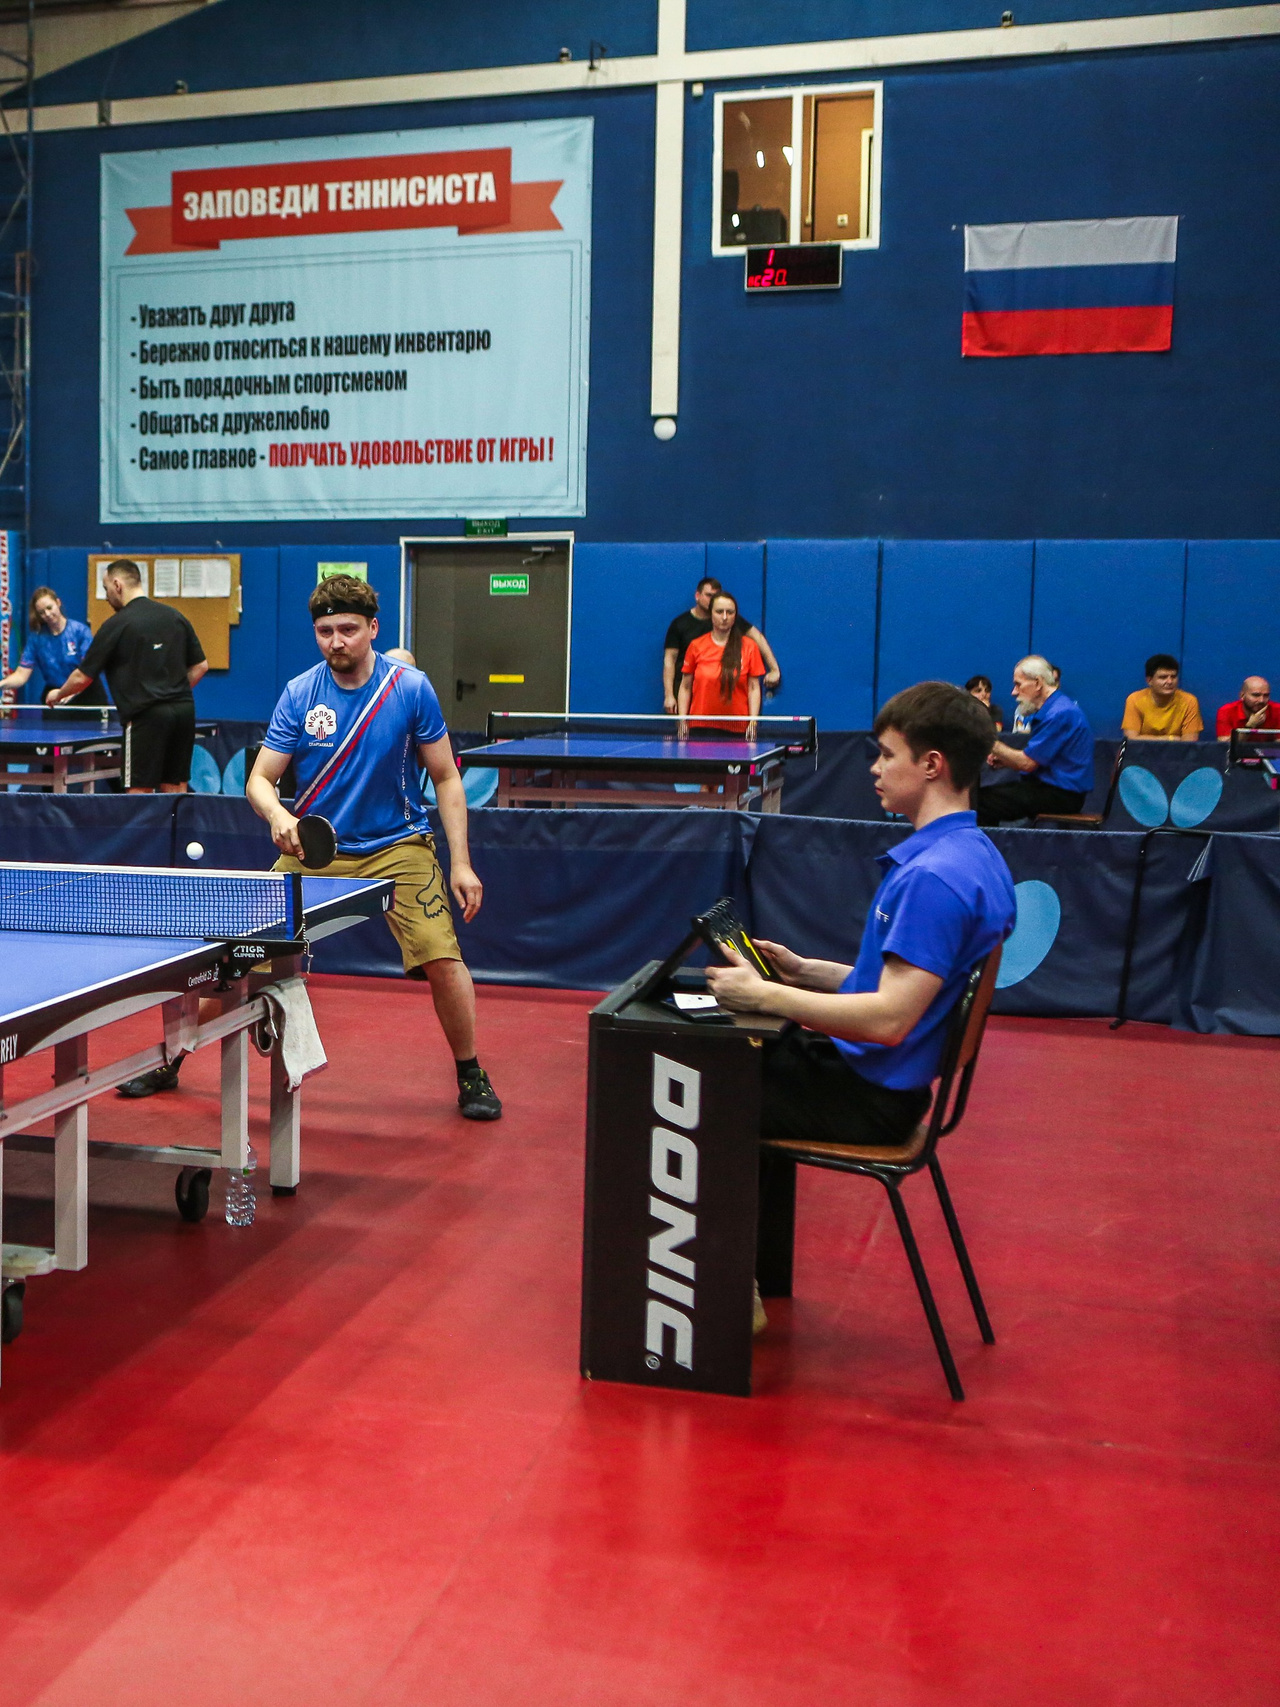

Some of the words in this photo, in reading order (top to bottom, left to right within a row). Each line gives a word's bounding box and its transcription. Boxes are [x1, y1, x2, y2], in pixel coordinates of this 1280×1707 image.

[183, 183, 320, 221] ЗАПОВЕДИ
[324, 171, 497, 212] ТЕННИСИСТА
[139, 303, 207, 329] Уважать
[209, 303, 246, 329] друг
[248, 300, 296, 327] друга
[139, 339, 211, 366] Бережно
[213, 336, 308, 361] относиться
[310, 336, 321, 357] к
[323, 333, 392, 357] нашему
[394, 329, 492, 354] инвентарю
[139, 375, 181, 400] Быть
[183, 373, 291, 400] порядочным
[293, 369, 408, 396] спортсменом
[139, 410, 219, 438] Общаться
[221, 405, 330, 437] дружелюбно
[139, 446, 189, 471] Самое
[192, 447, 257, 470] главное
[269, 441, 347, 468] ПОЛУЧАТЬ
[350, 438, 473, 470] УДОВОЛЬСТВИЕ
[476, 438, 497, 464] ОТ
[499, 437, 545, 463] ИГРЫ
[471, 519, 501, 527] ВЫХОД
[492, 579, 527, 589] ВЫХОД
[307, 710, 334, 728] МОСПРОМ
[232, 945, 265, 954] STIGA
[646, 1051, 701, 1372] DONIC
